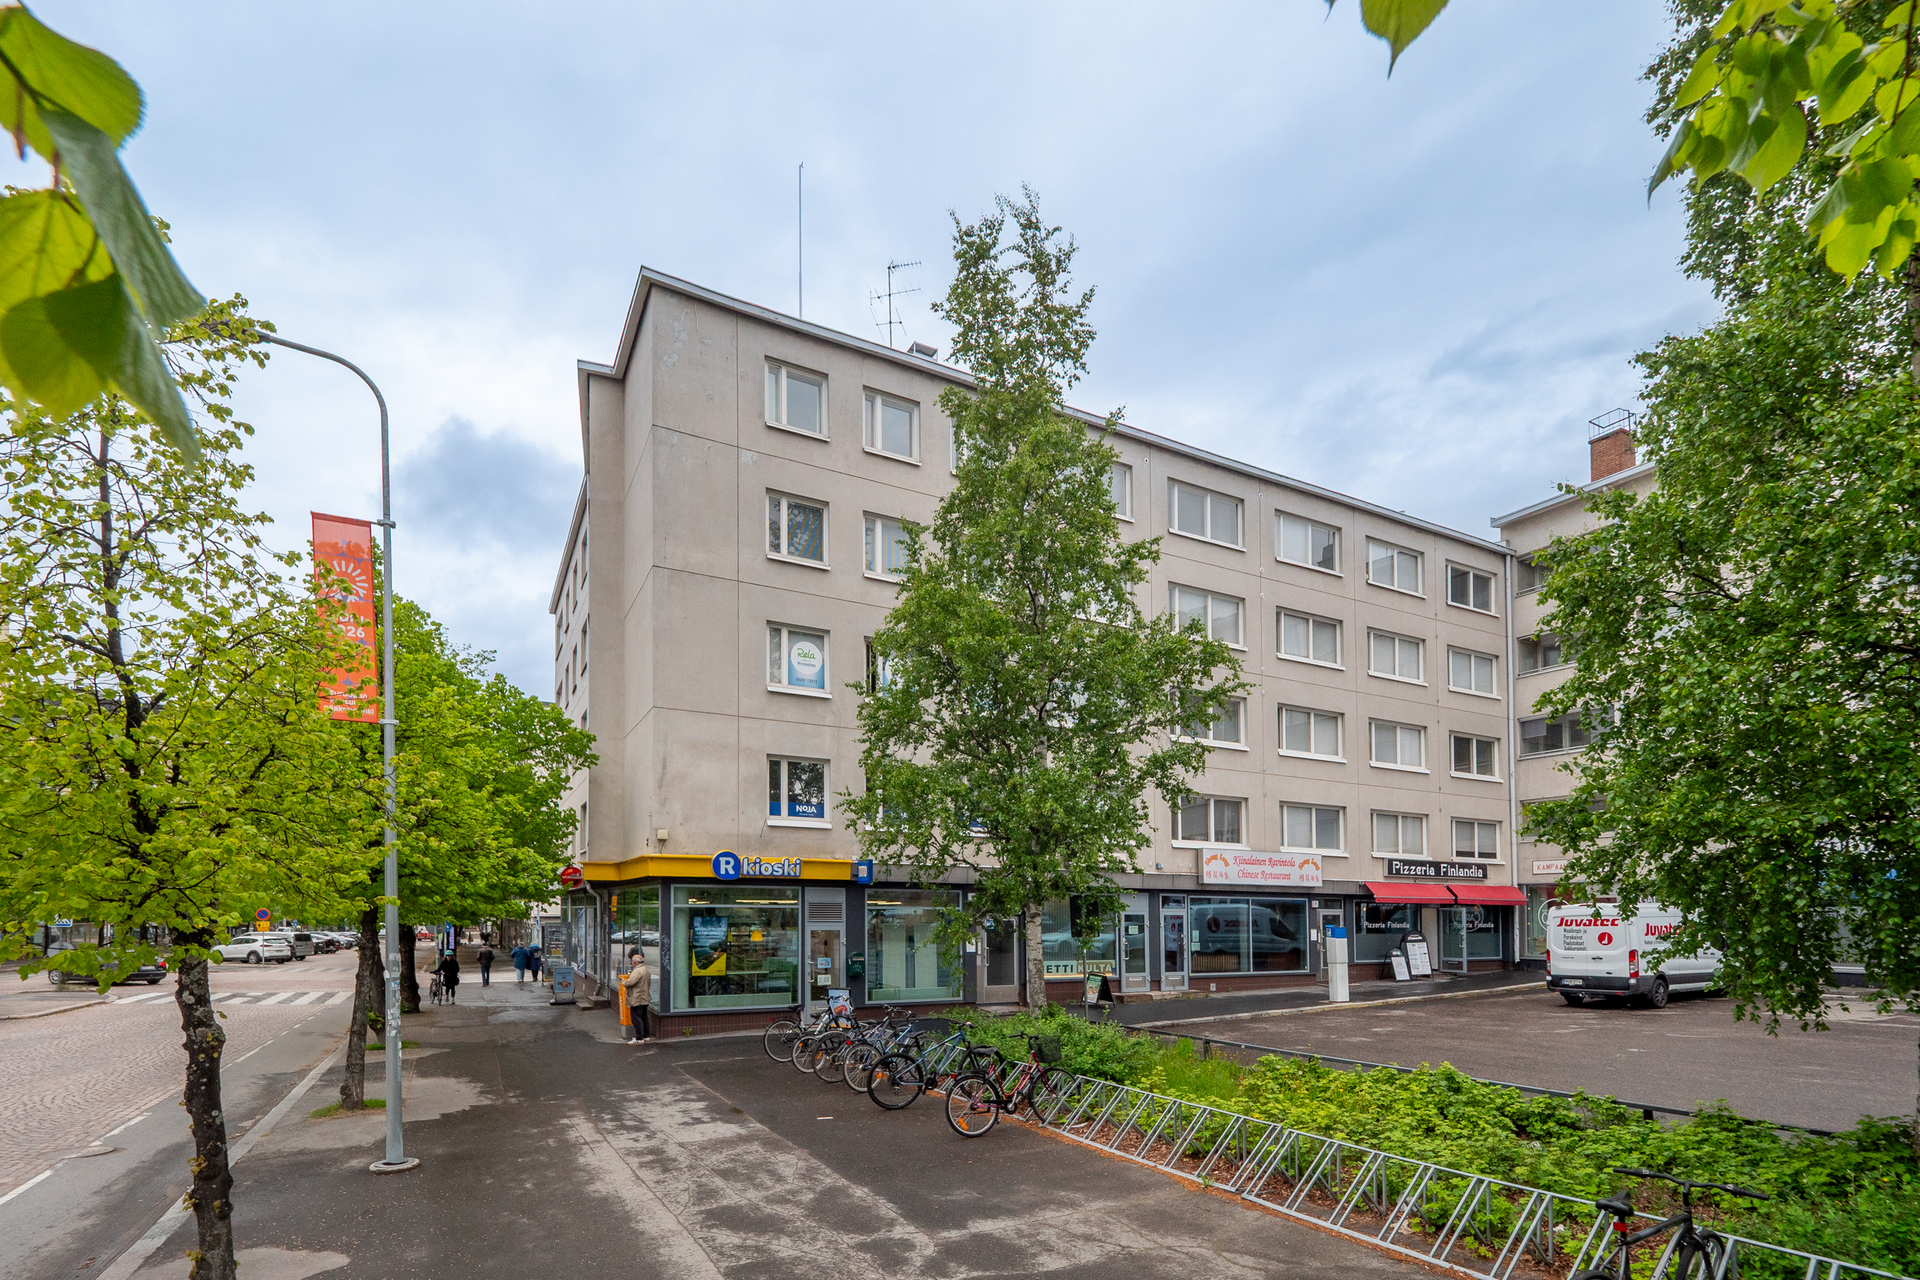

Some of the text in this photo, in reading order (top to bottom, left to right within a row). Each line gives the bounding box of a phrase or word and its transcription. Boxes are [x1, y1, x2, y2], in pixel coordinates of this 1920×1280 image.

[797, 647, 816, 660] Rela
[718, 856, 801, 877] R kioski
[1233, 855, 1267, 867] Kiinalainen
[1267, 857, 1296, 868] Ravintola
[1237, 869, 1260, 881] Chinese
[1260, 870, 1291, 881] Restaurant
[1392, 861, 1484, 877] Pizzeria Finlandia
[1363, 921, 1385, 929] Pizzeria
[1474, 921, 1494, 929] Finlandia
[1557, 917, 1620, 927] Juvatec
[1046, 964, 1112, 973] ETTI KULTA
